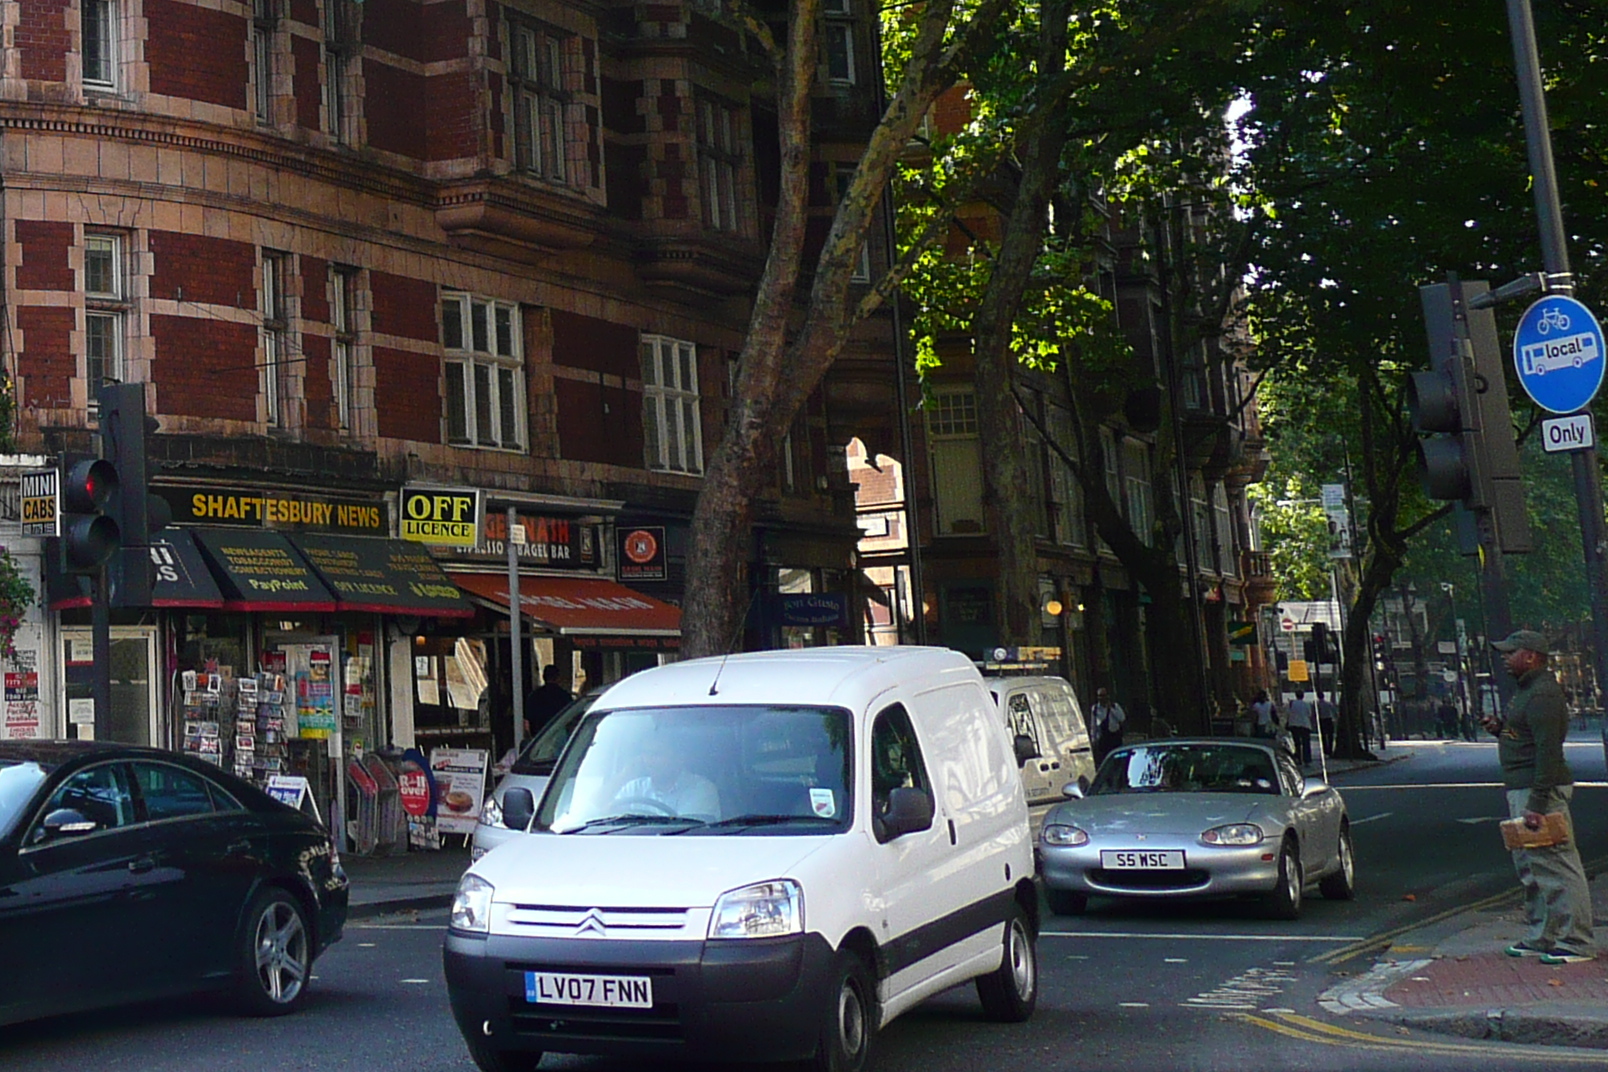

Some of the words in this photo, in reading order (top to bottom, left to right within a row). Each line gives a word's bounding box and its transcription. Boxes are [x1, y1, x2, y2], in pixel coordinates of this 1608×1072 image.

[1546, 338, 1582, 359] local
[1550, 423, 1584, 444] Only
[23, 474, 55, 497] MINI
[23, 498, 55, 520] CABS
[192, 492, 333, 526] SHAFTESBURY
[337, 505, 380, 528] NEWS
[407, 494, 471, 521] OFF
[407, 522, 471, 537] LICENCE
[551, 545, 570, 559] BAR
[248, 579, 309, 592] PayPoint
[1117, 853, 1135, 866] S5
[539, 977, 595, 1000] LV07
[603, 980, 648, 1003] FNN
